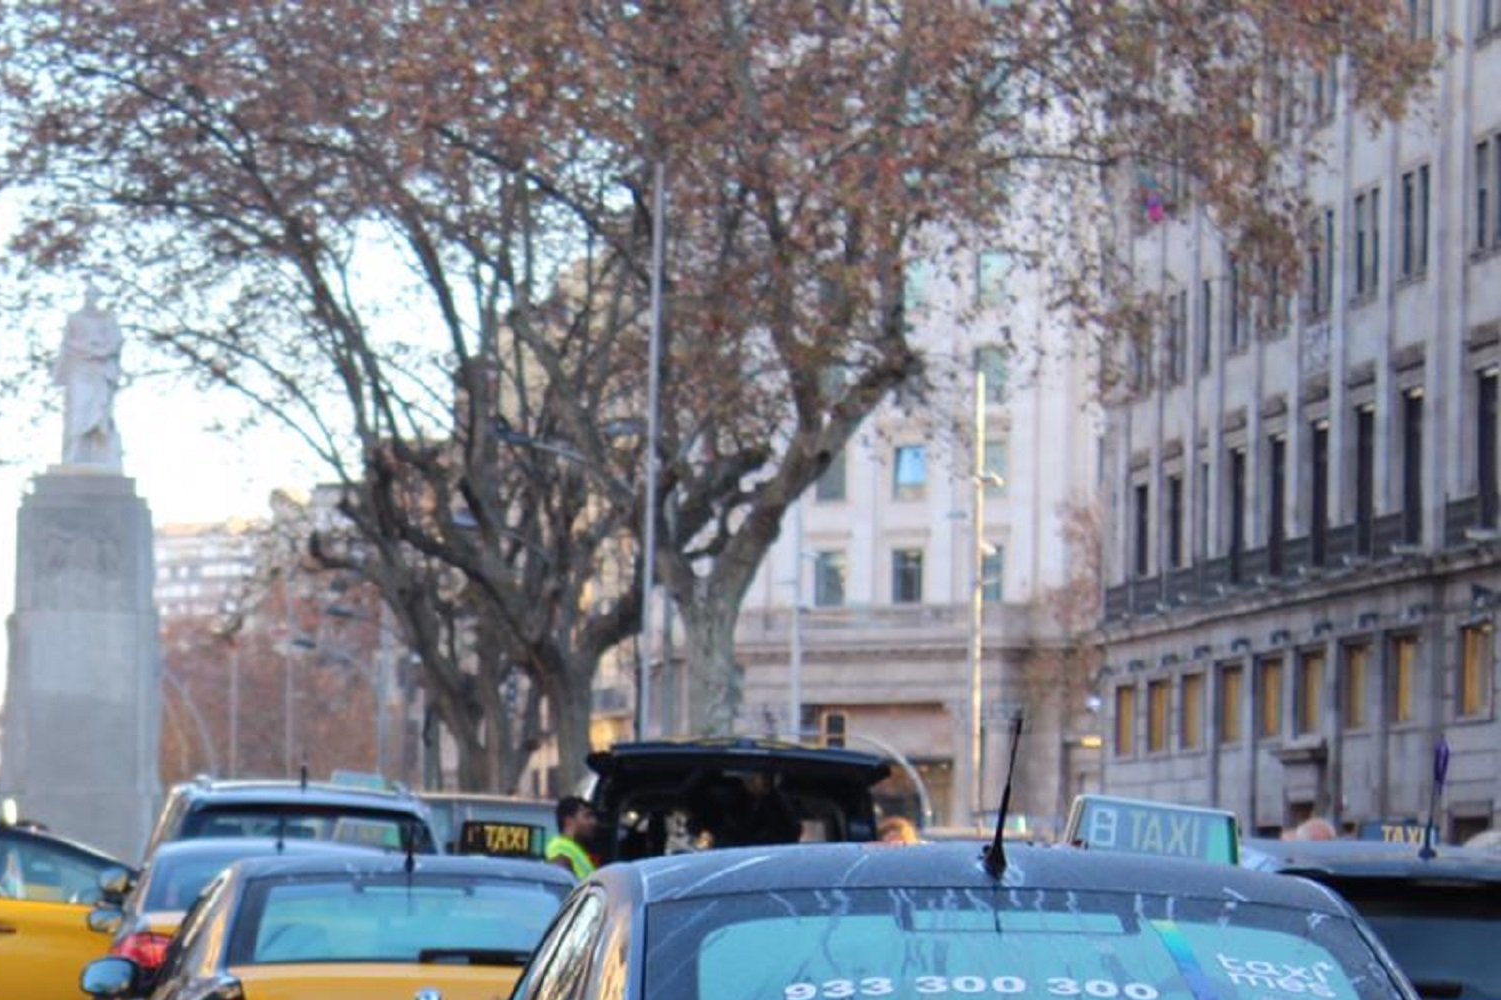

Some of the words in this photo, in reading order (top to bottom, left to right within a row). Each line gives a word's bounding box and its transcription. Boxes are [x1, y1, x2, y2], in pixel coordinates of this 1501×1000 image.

[483, 825, 529, 851] TAXI
[1129, 811, 1201, 857] TAXI
[915, 975, 1027, 994] 300
